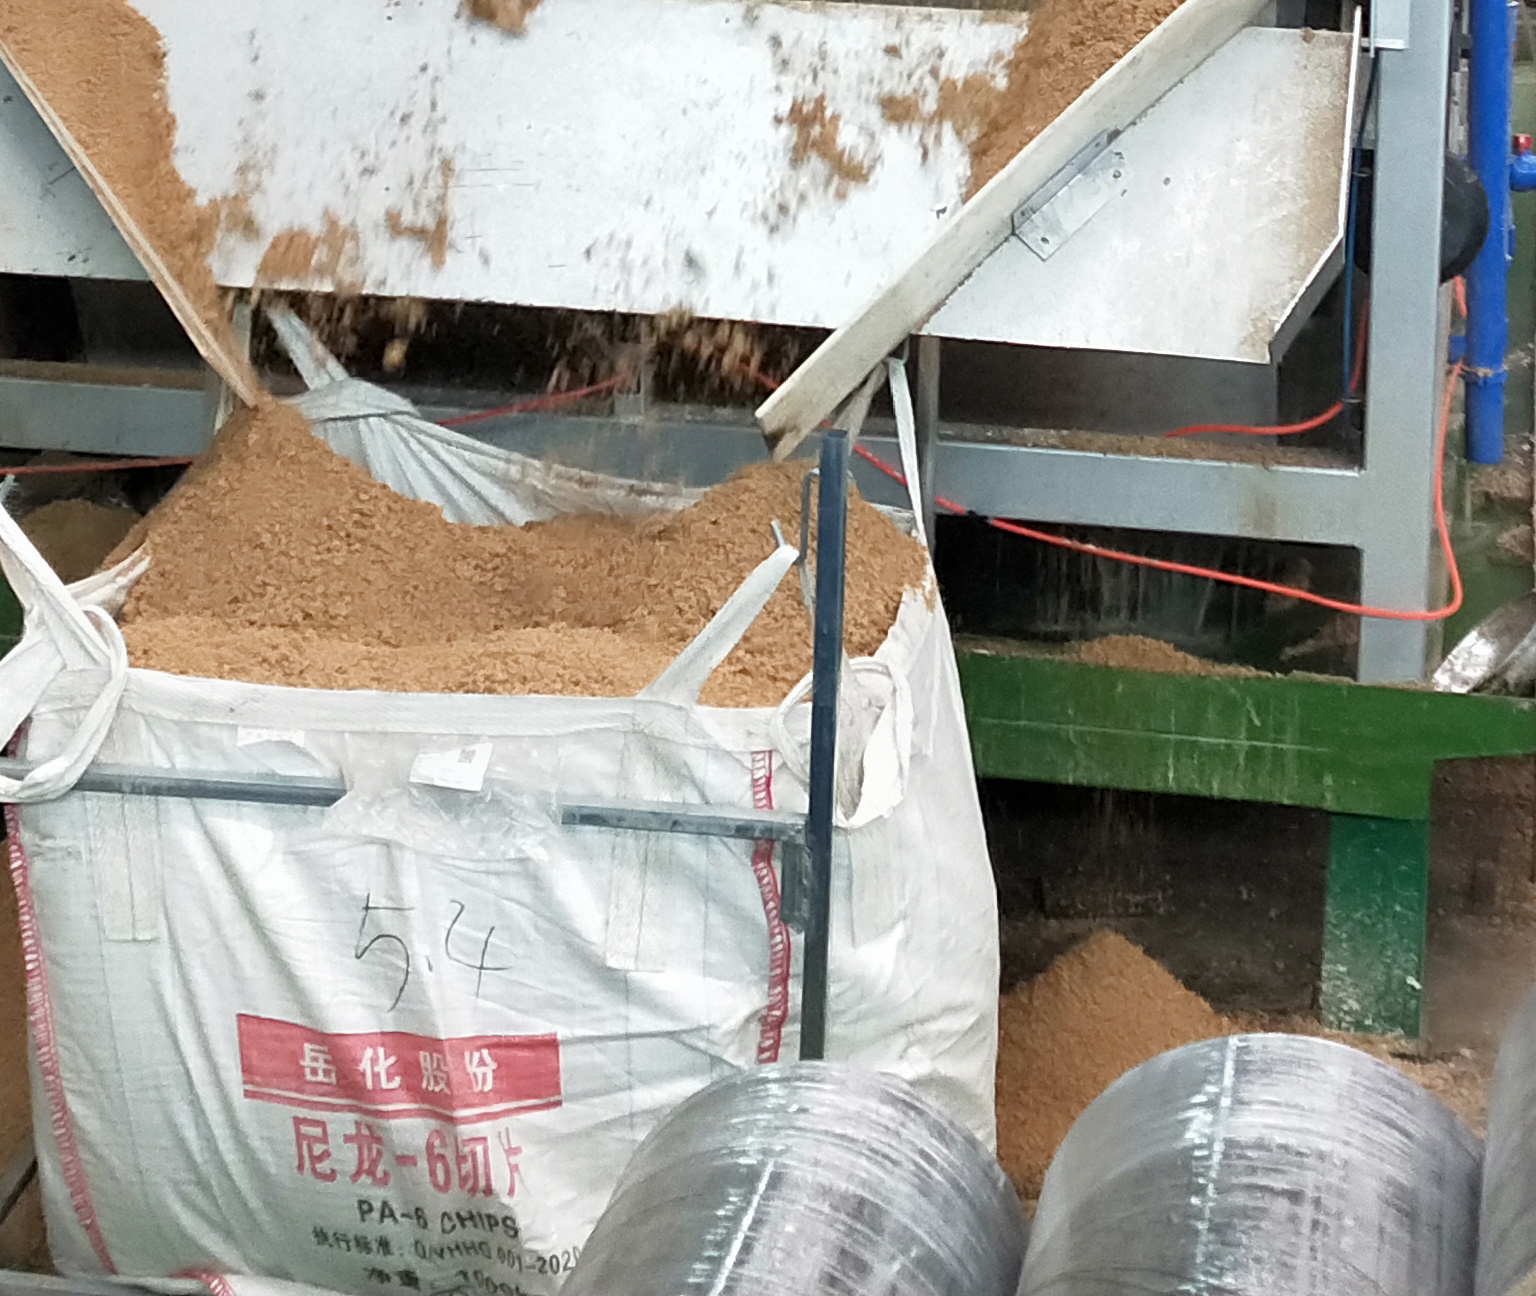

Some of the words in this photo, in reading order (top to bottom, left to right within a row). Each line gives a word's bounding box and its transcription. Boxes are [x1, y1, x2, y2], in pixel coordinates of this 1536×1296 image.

[354, 891, 514, 1014] 5.4
[299, 1042, 499, 1095] 岳化股份
[292, 1115, 526, 1198] 尼龙-6切片
[440, 1209, 520, 1239] CHIPS
